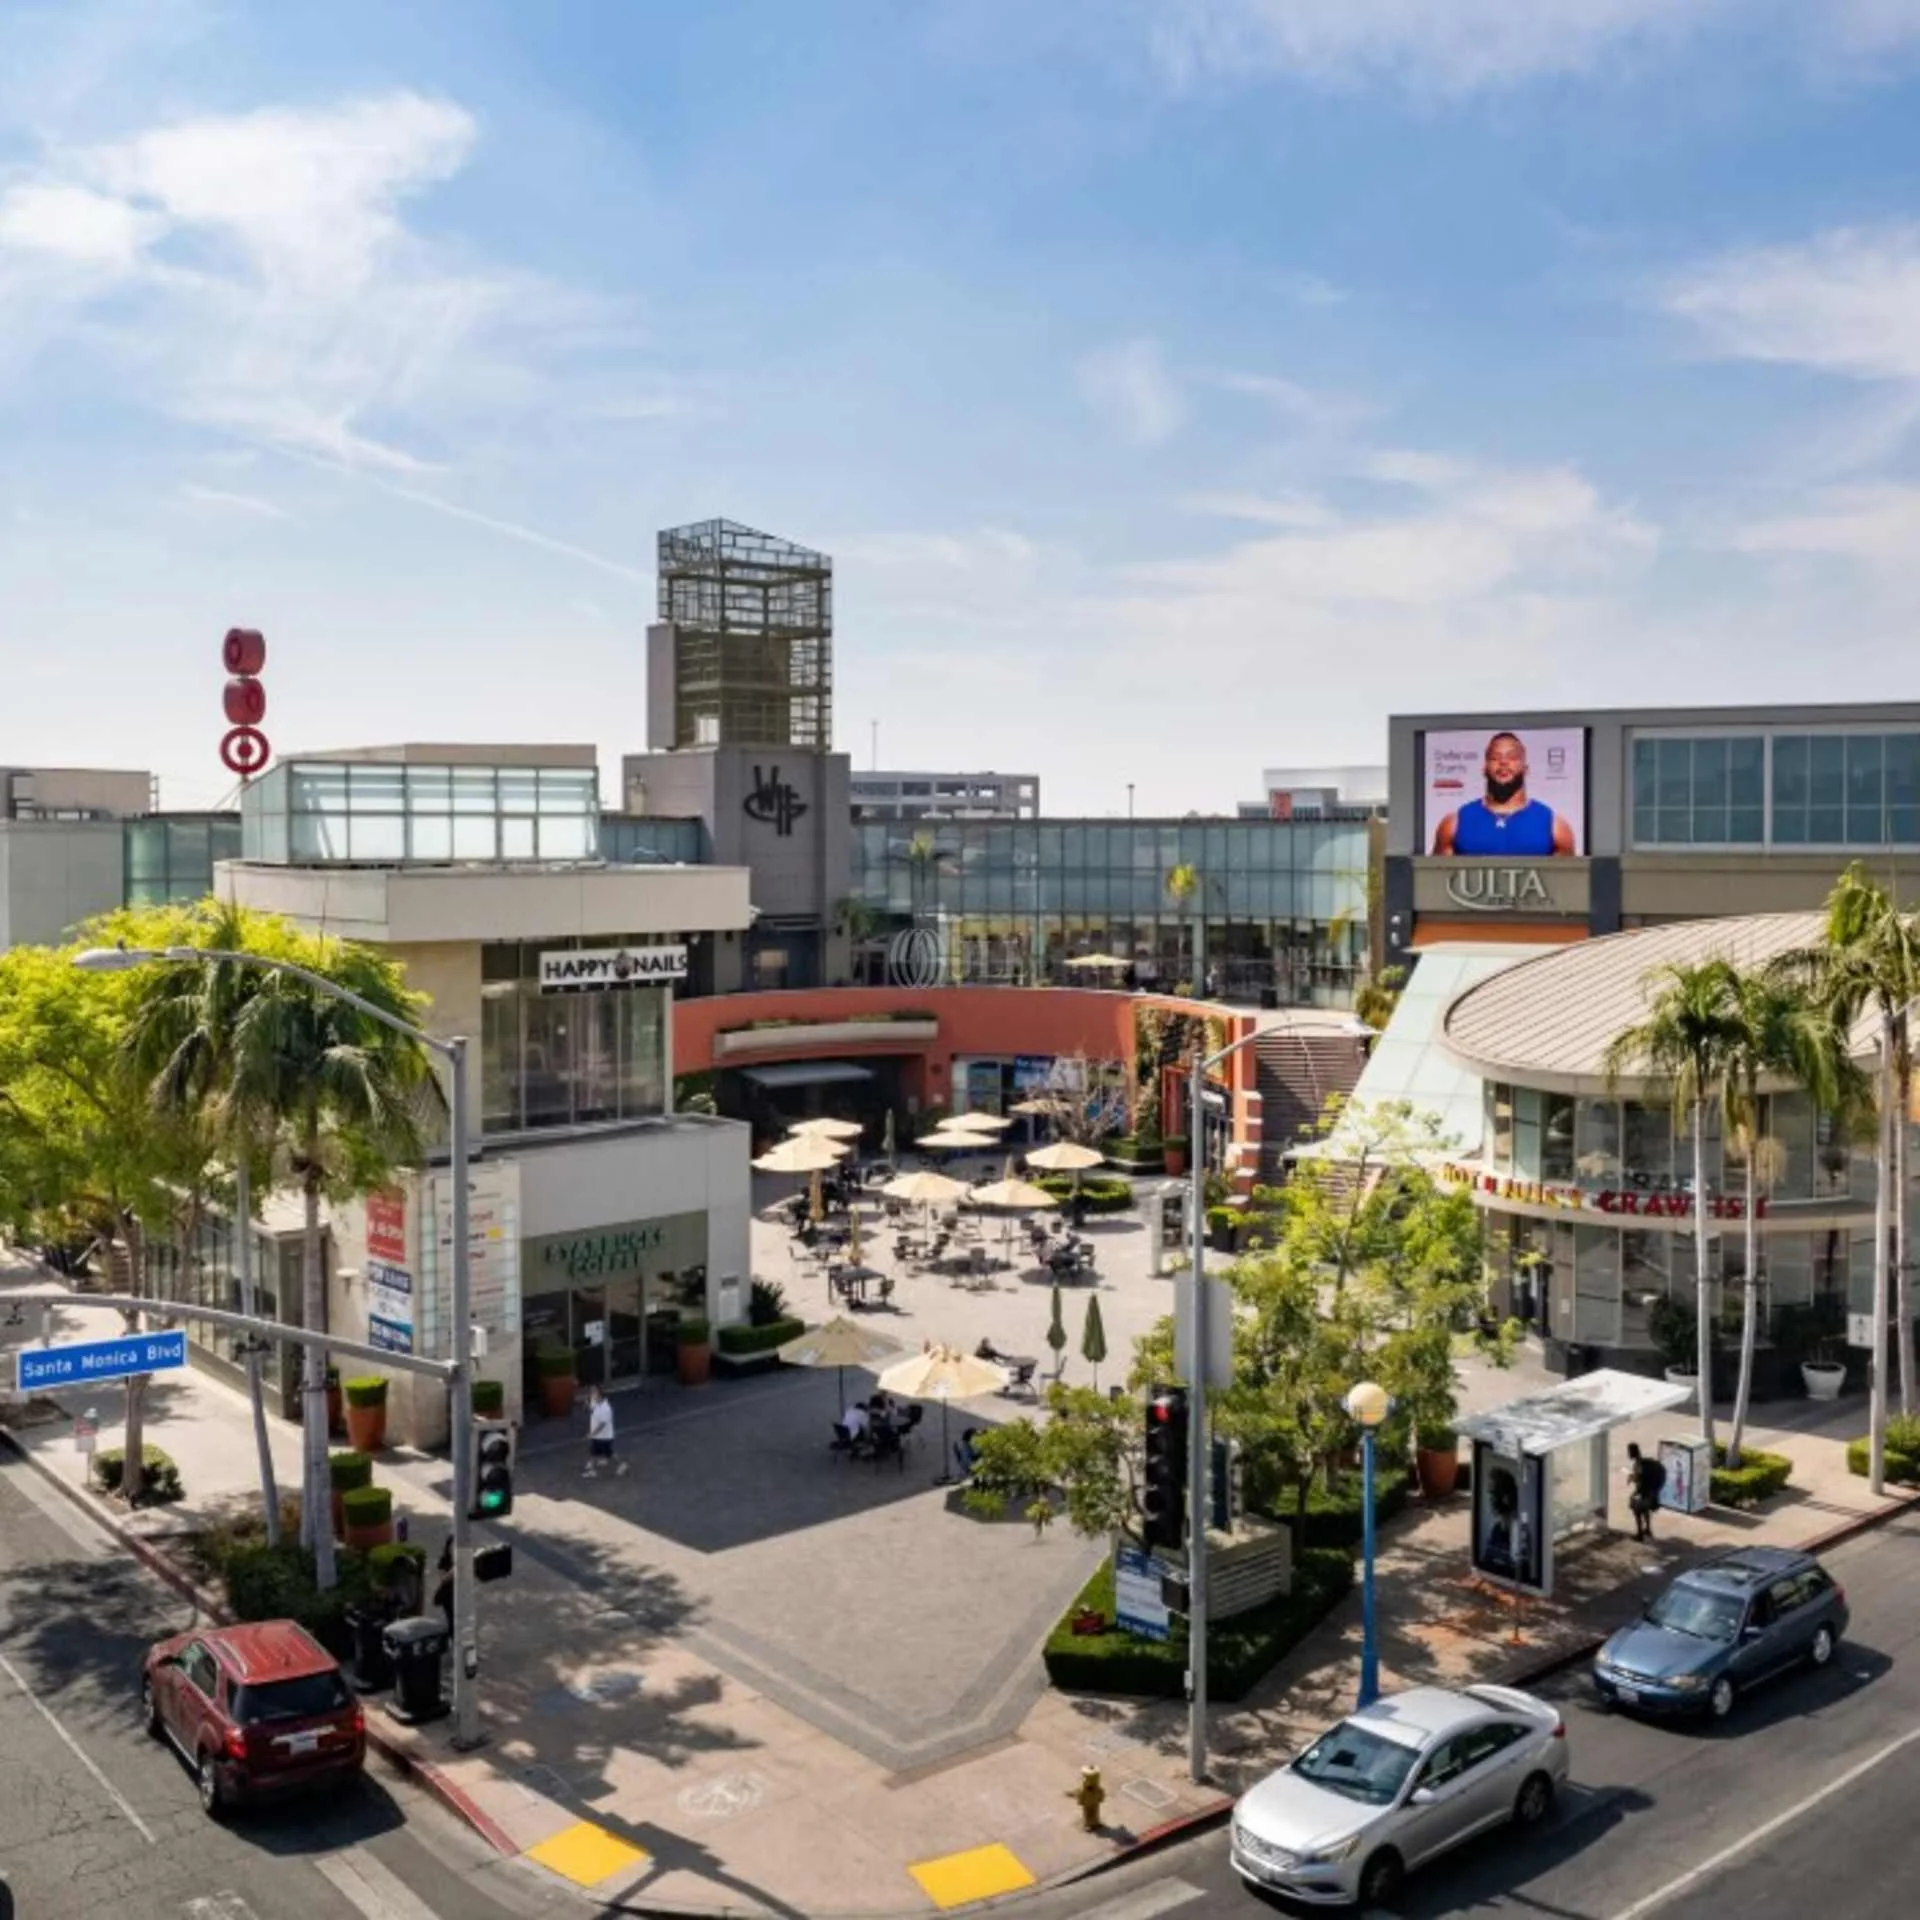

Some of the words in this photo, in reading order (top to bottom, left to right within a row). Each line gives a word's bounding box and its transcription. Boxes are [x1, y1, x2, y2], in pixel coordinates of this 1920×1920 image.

[1459, 868, 1547, 898] ULTA
[545, 957, 615, 979] HAPPY
[633, 953, 688, 973] NAILS
[24, 1358, 73, 1378] Santa
[81, 1349, 139, 1369] Monica
[147, 1341, 182, 1360] Blvd
